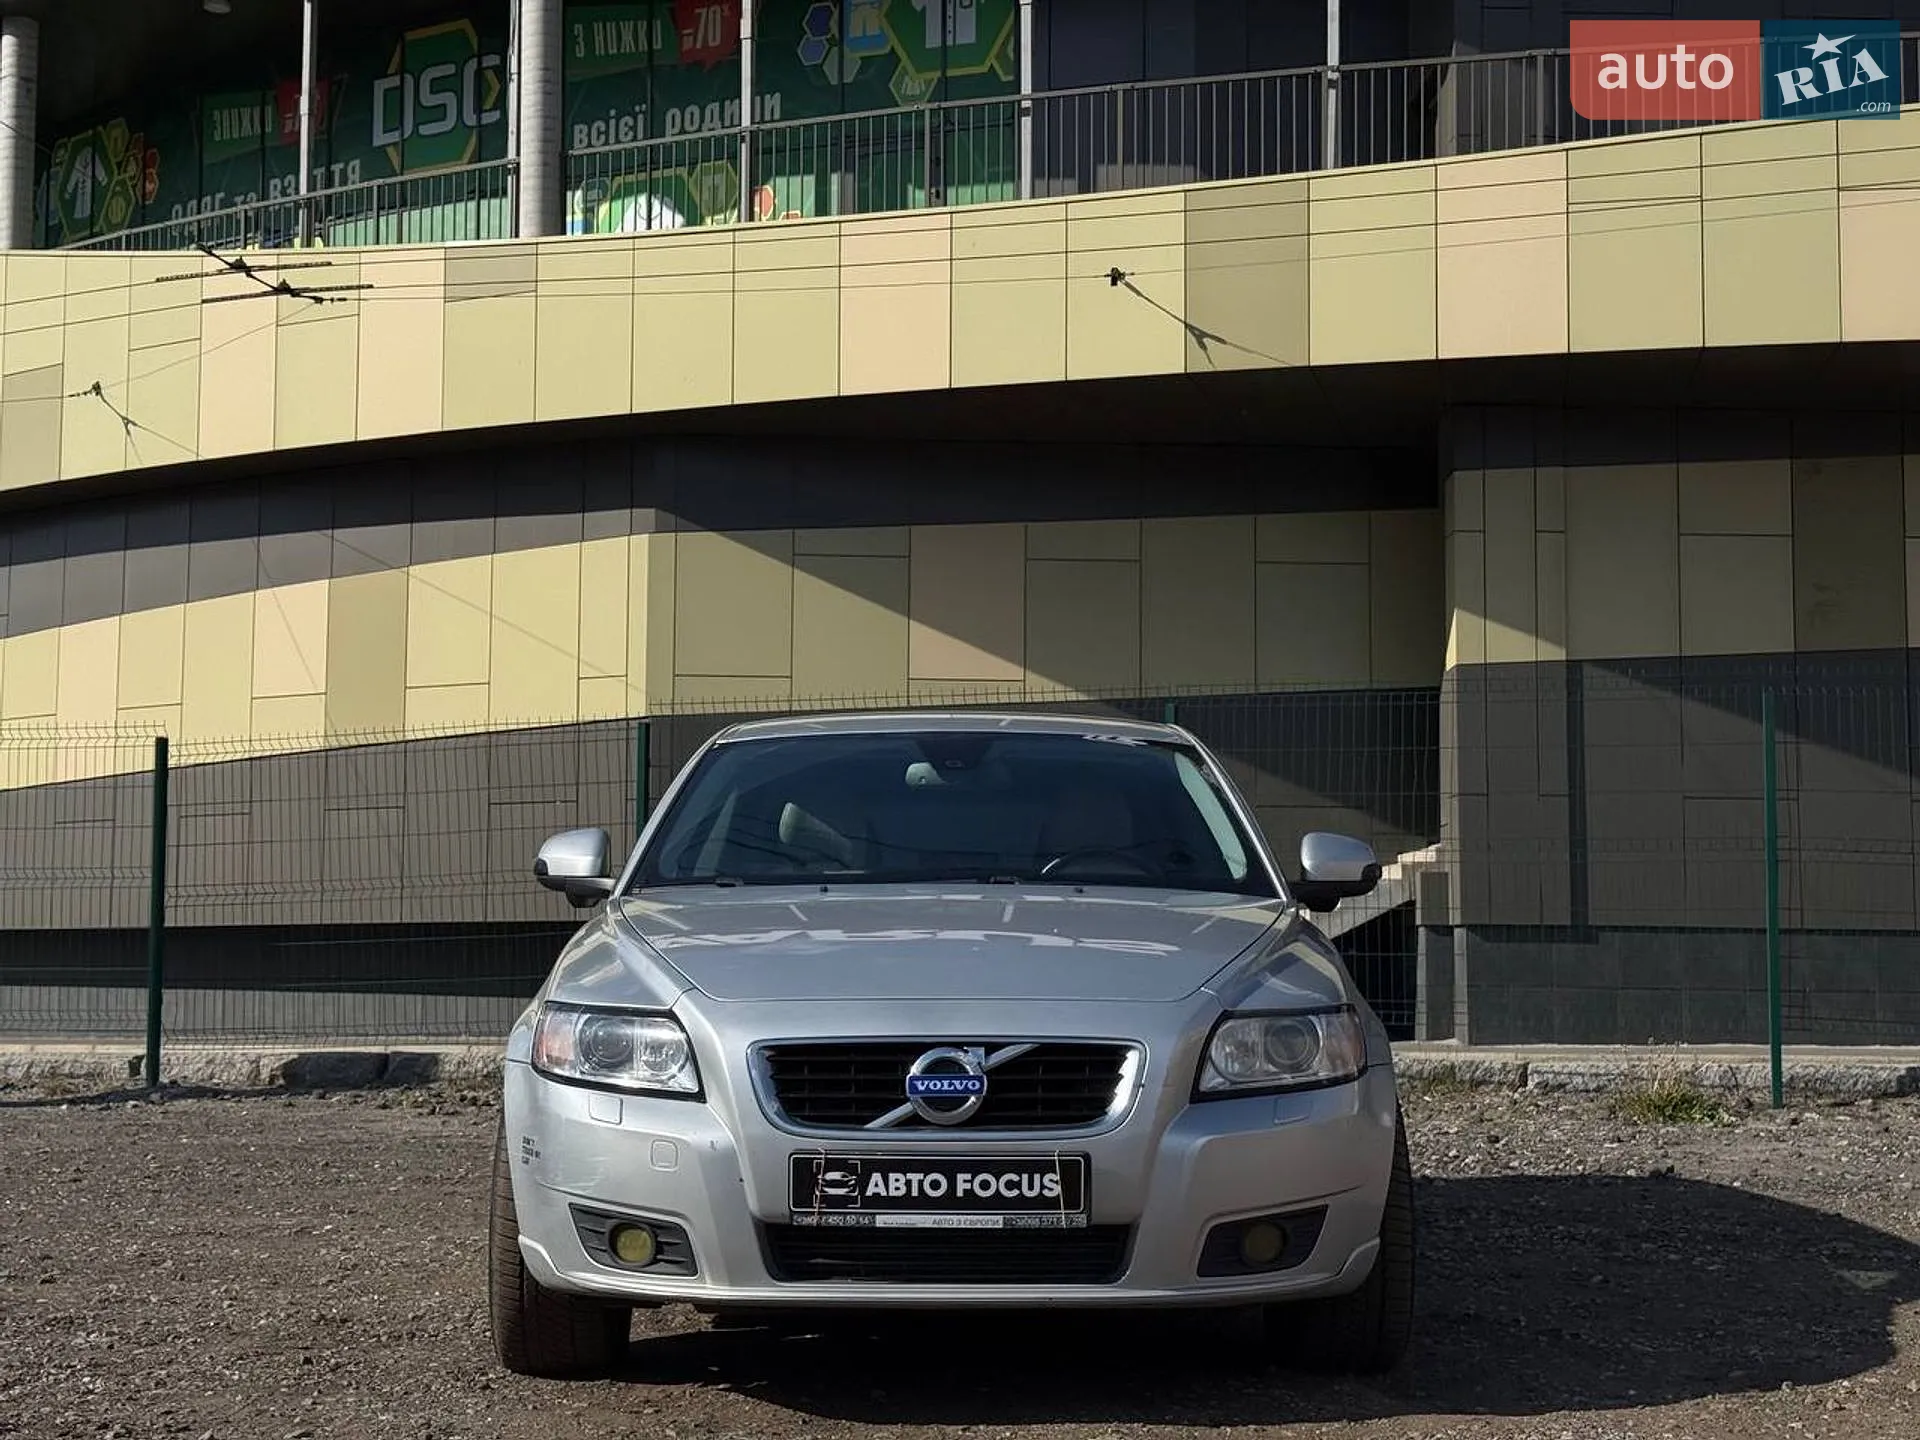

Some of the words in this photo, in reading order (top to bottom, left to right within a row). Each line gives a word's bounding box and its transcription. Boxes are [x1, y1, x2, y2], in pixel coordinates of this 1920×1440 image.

[372, 54, 501, 147] DSC
[573, 104, 647, 149] всієї
[269, 158, 361, 210] ВЗТТЯ
[913, 1079, 981, 1092] VOLVO
[865, 1173, 948, 1198] АВТО
[956, 1173, 1061, 1198] FOCUS
